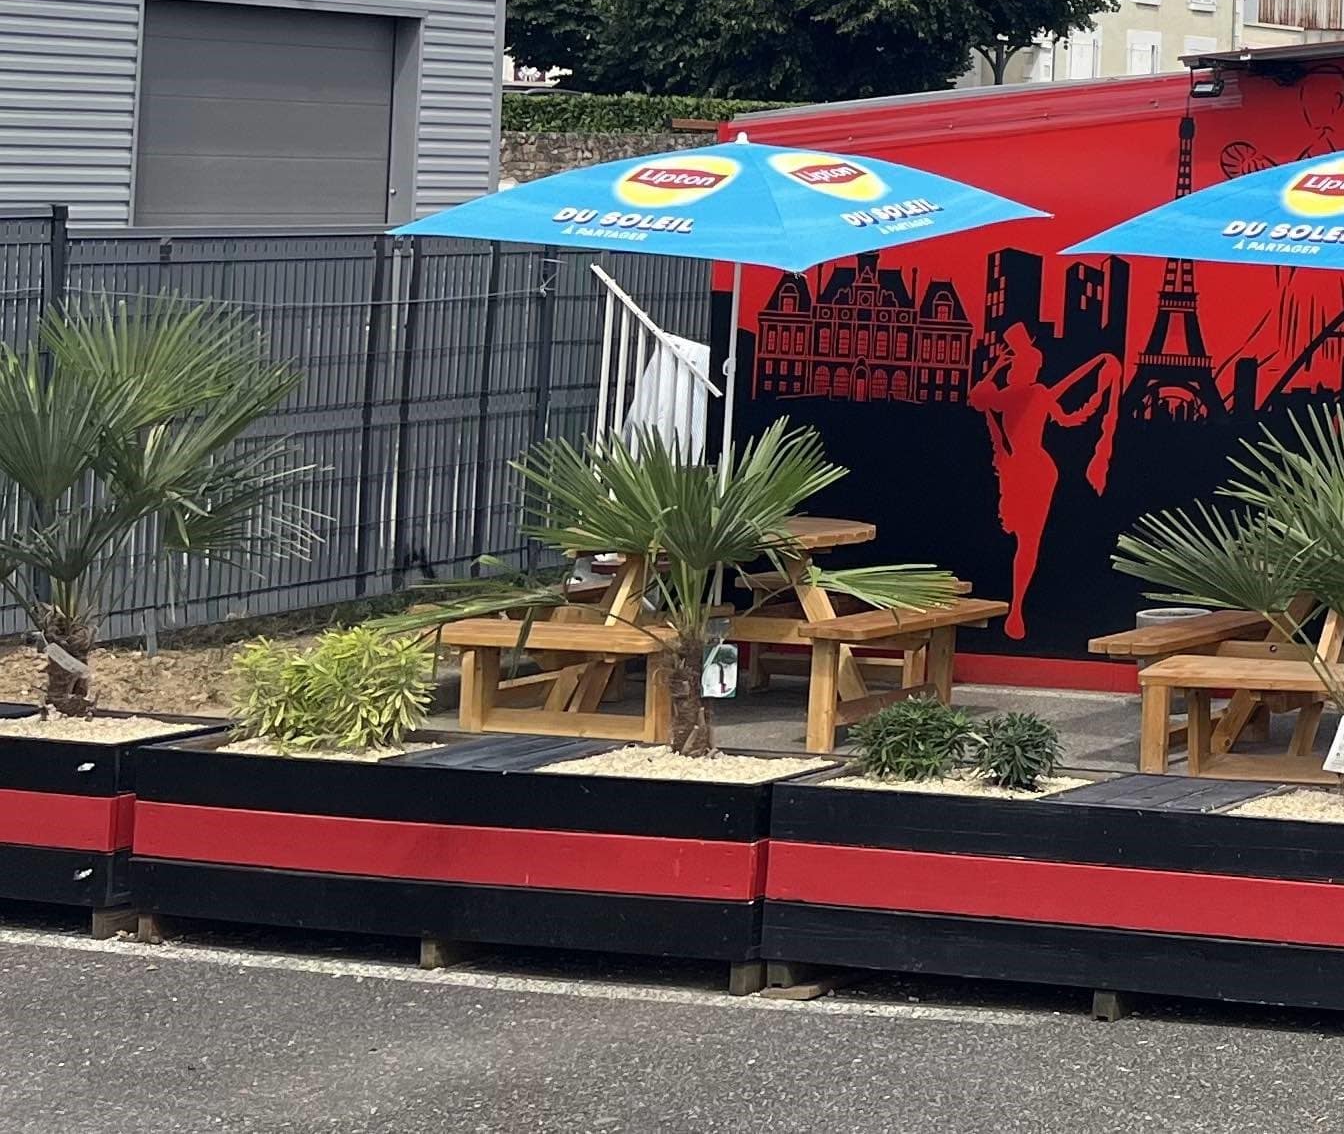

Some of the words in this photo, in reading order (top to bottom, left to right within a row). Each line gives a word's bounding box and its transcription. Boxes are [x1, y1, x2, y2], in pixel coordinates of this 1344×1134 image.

[638, 169, 715, 187] Lipton
[795, 166, 858, 182] Lipton
[552, 207, 597, 223] DU
[600, 211, 695, 234] SOLEIL
[1222, 220, 1267, 238] DU
[561, 225, 573, 235] À
[575, 227, 649, 241] PARTAGER
[1233, 239, 1245, 250] À
[1247, 241, 1321, 255] PARTAGER
